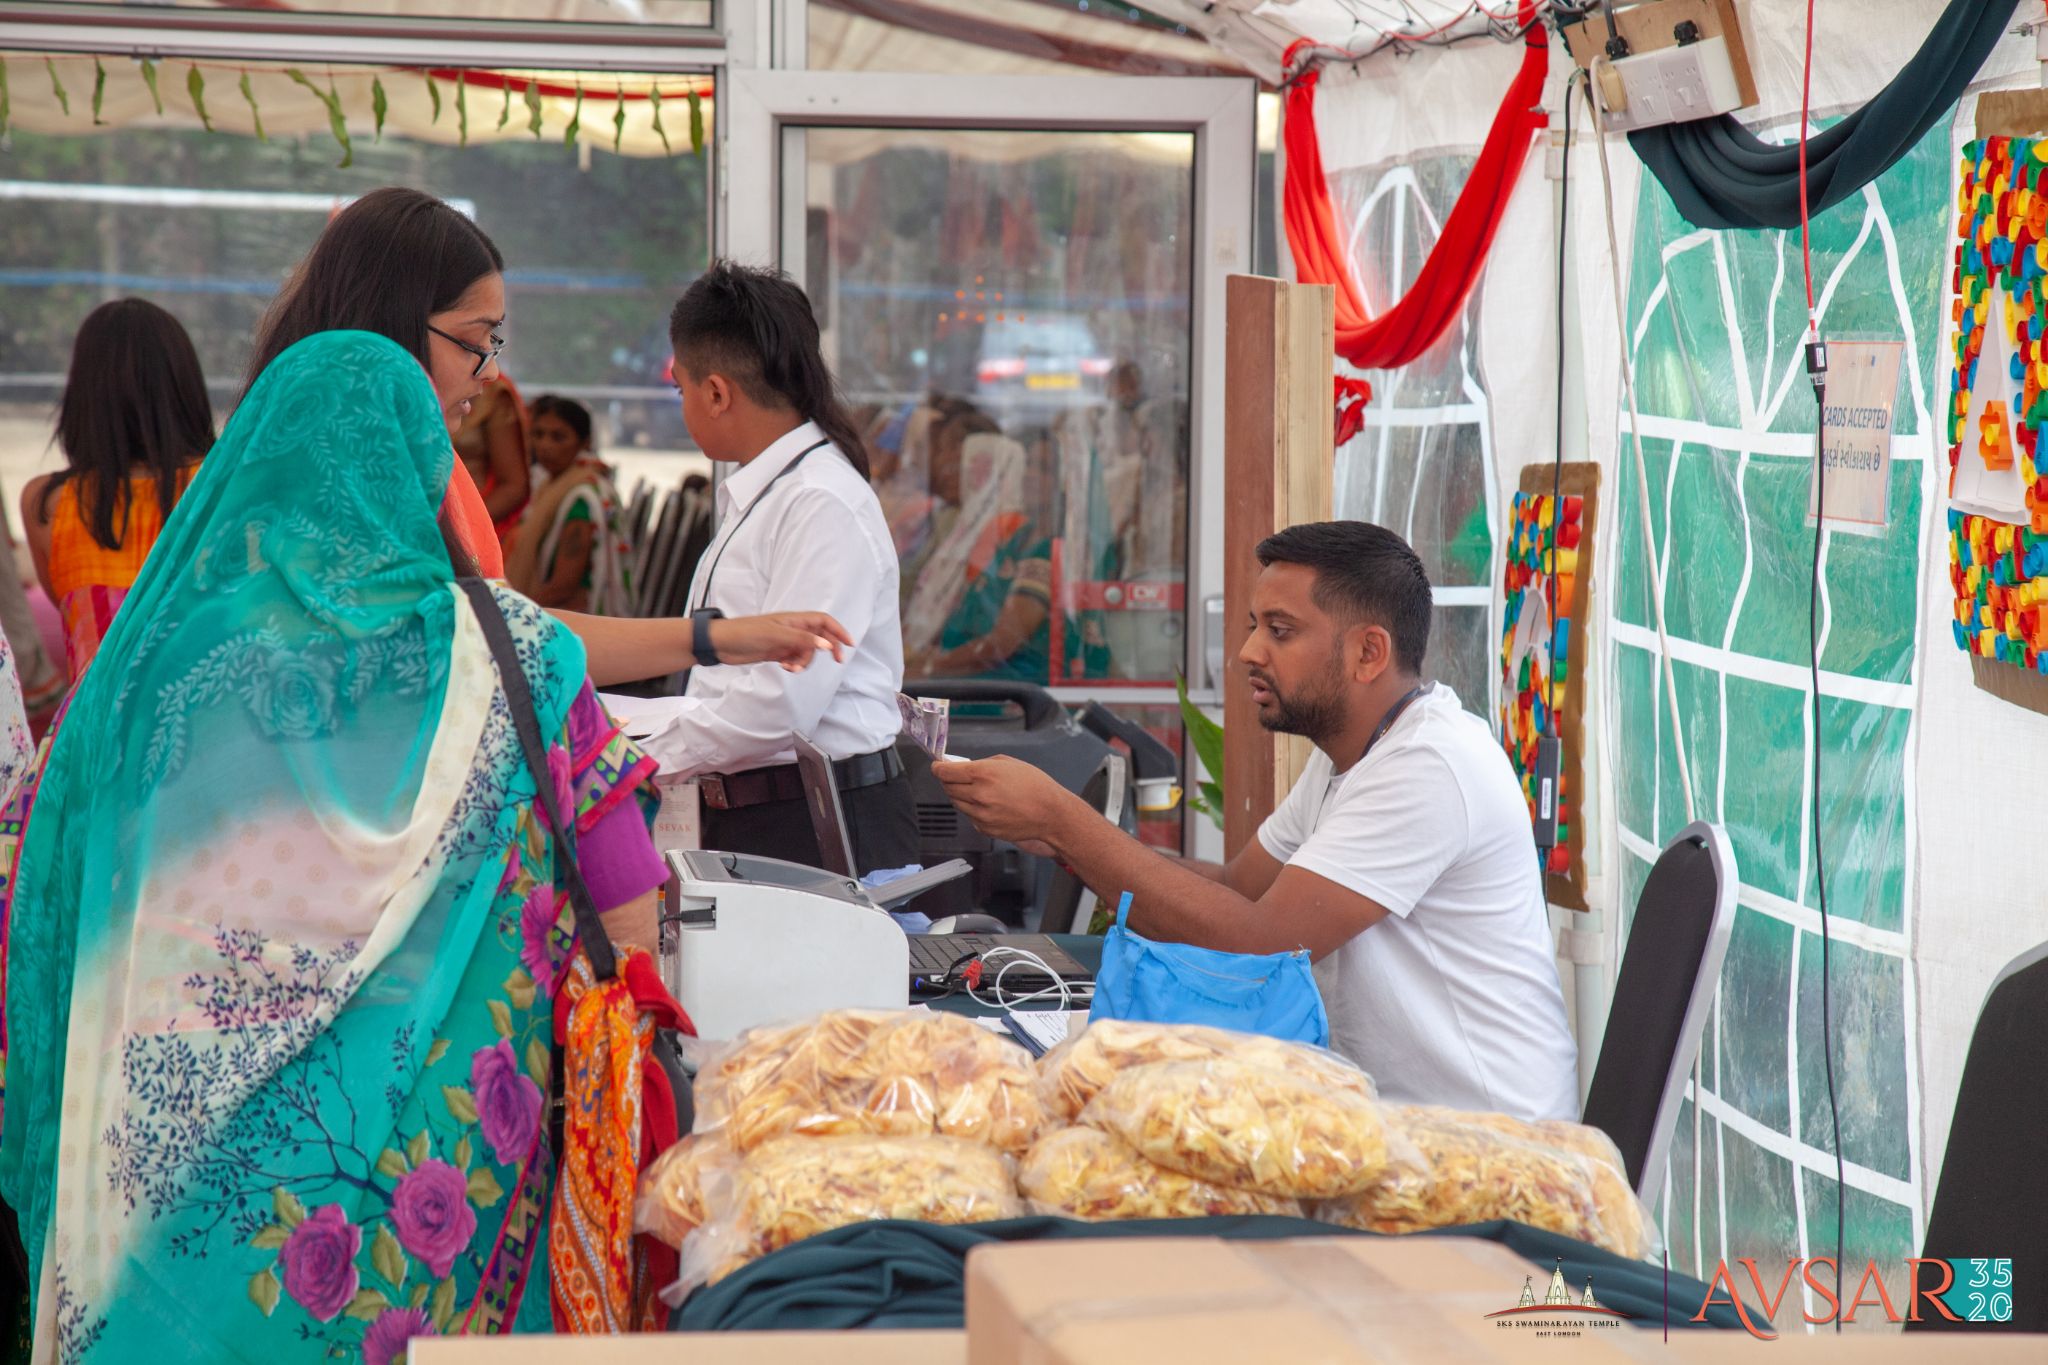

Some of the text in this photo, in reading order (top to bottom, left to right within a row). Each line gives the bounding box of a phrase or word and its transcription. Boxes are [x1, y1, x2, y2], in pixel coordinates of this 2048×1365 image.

[1823, 406, 1888, 429] CARDS ACCEPTED
[1873, 444, 1881, 472] છે
[657, 823, 692, 832] SEVAK
